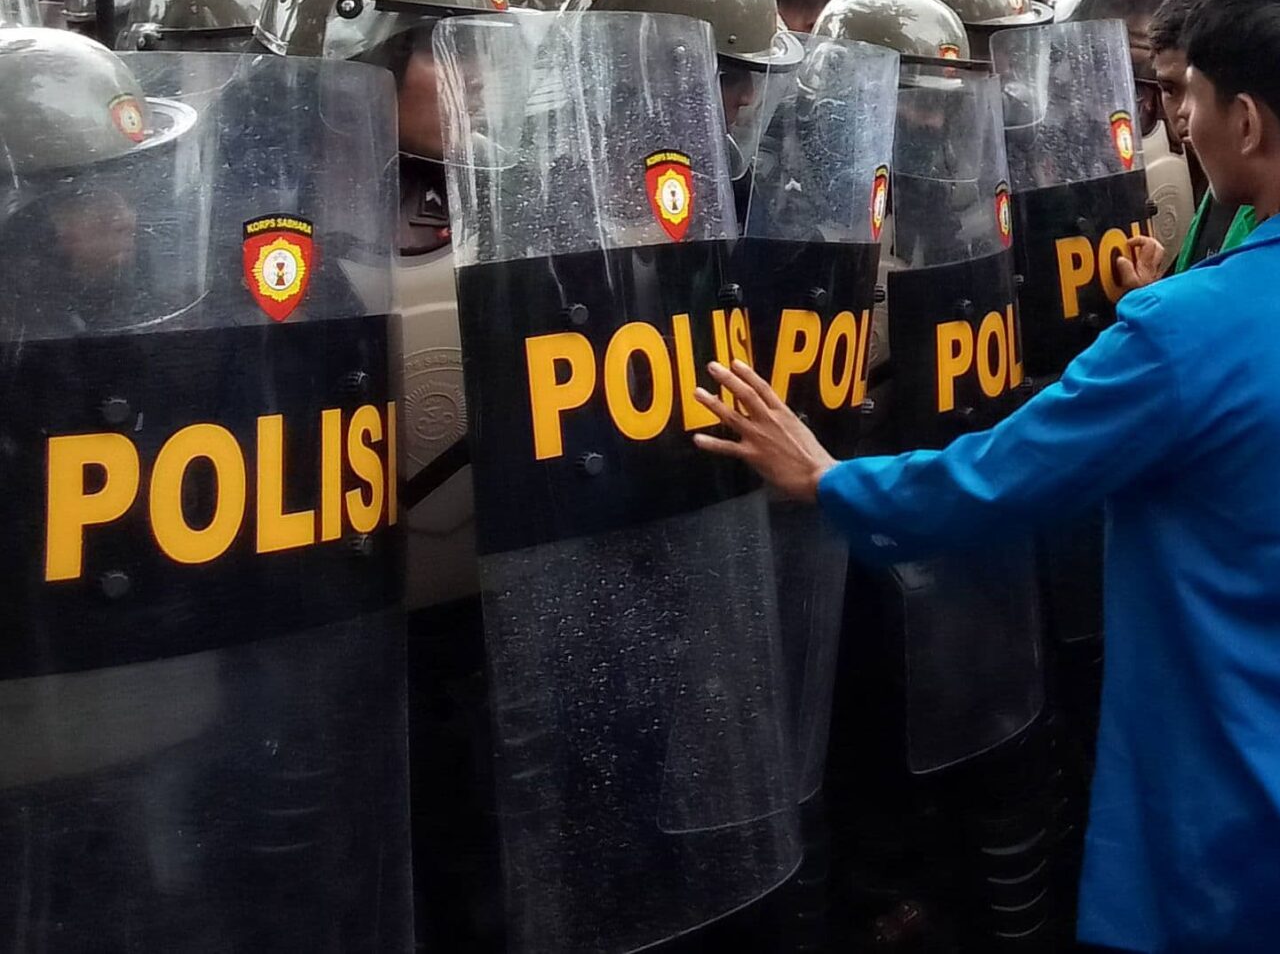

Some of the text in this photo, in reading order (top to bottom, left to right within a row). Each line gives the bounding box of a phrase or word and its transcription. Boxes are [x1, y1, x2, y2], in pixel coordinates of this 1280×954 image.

[247, 218, 275, 233] KORPS
[1055, 218, 1154, 319] PO
[525, 308, 753, 460] POLIS
[45, 400, 397, 582] POLISI
